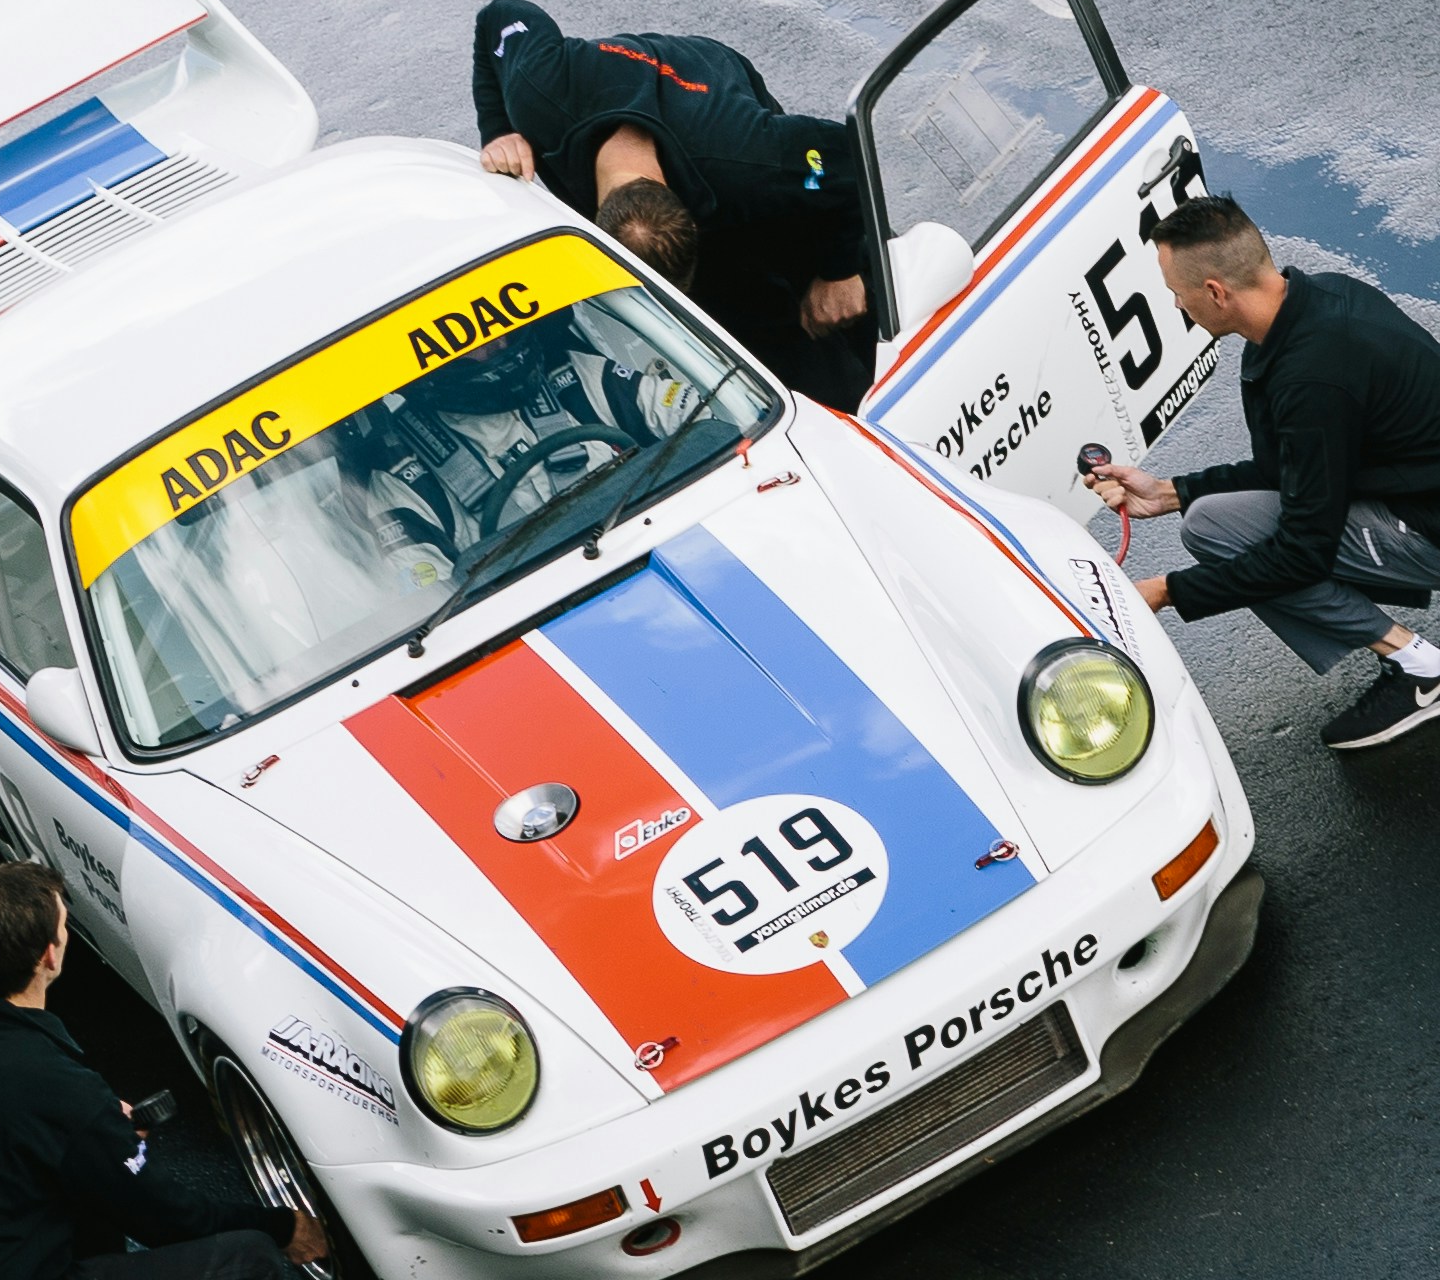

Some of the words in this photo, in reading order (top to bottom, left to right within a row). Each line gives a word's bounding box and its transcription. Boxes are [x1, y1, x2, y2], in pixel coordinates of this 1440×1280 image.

[407, 281, 540, 370] ADAC
[936, 372, 1010, 458] oykes
[969, 390, 1053, 481] orsche
[159, 409, 292, 513] ADAC
[52, 816, 121, 893] Boykes
[642, 809, 688, 842] Enke
[682, 806, 854, 927] 519
[751, 876, 859, 944] youngtimer.de
[700, 1059, 892, 1181] Boykes
[902, 932, 1099, 1071] Porsche
